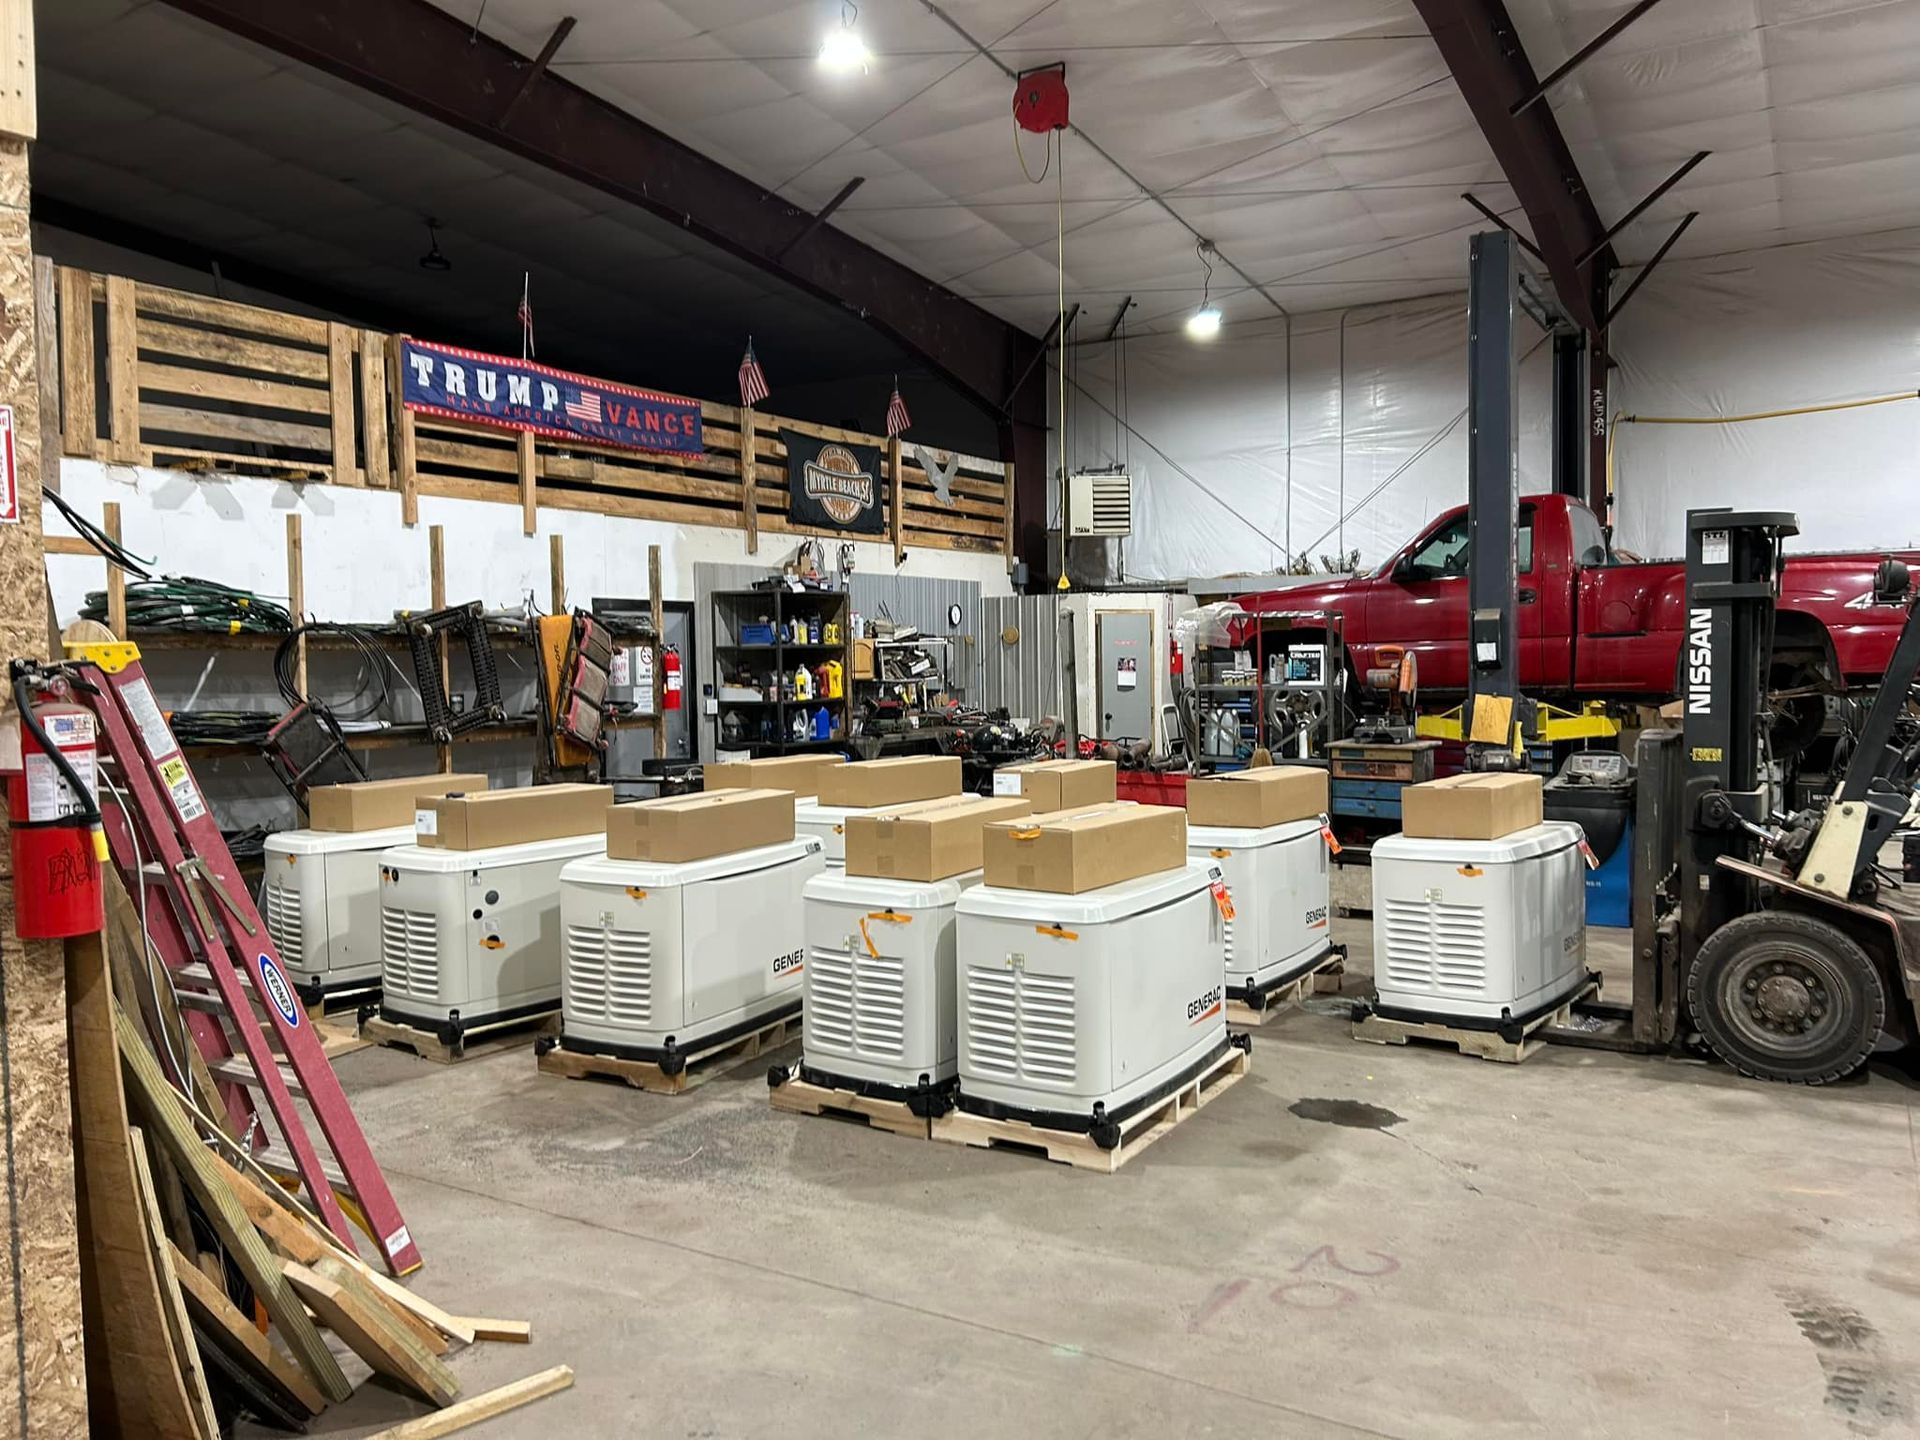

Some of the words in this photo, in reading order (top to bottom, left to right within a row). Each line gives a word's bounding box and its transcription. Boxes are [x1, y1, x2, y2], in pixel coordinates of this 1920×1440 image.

[410, 352, 559, 411] TRUMP
[446, 395, 491, 413] MAKE
[504, 405, 571, 427] AMERICA
[606, 401, 695, 436] VANCE
[809, 468, 837, 491] MYRTLE
[1689, 608, 1712, 714] NISSAN
[266, 968, 292, 1012] WERNER
[1187, 985, 1221, 1019] GENERAC
